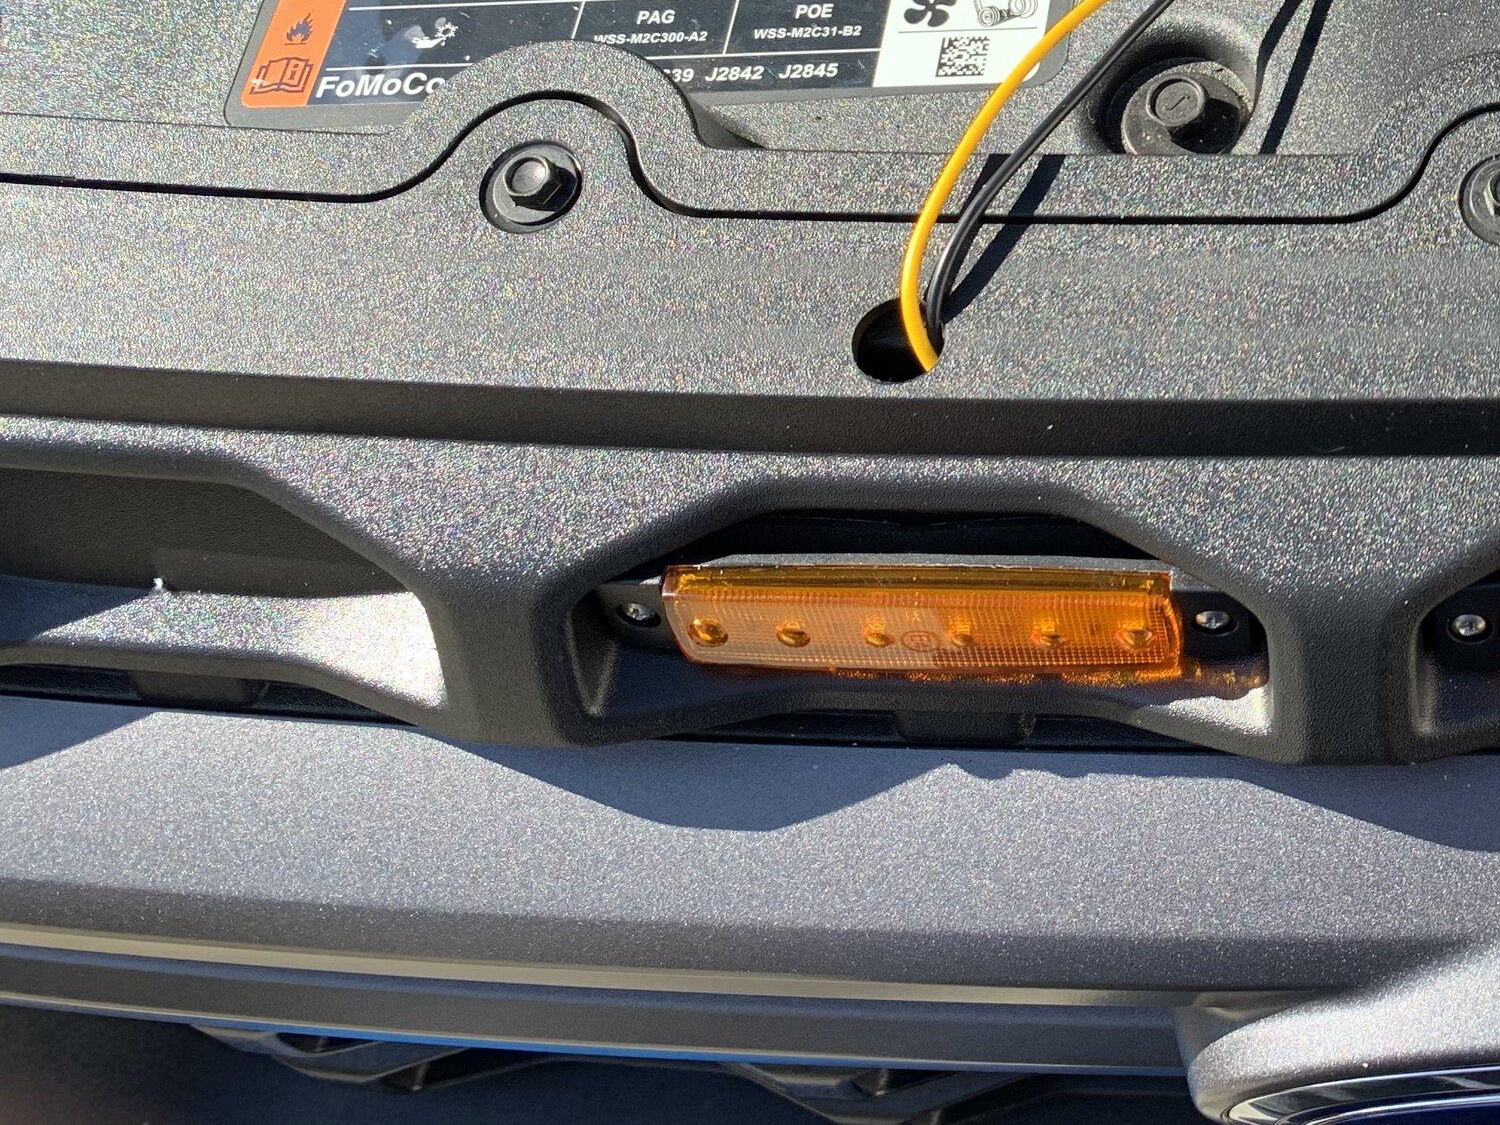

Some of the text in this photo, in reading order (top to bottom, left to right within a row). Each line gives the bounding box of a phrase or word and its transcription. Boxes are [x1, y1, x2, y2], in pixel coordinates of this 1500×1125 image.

[636, 10, 675, 25] PAG
[795, 4, 834, 19] POE
[753, 26, 862, 40] WSS-M2C31-B2
[705, 66, 765, 82] J2842
[779, 63, 838, 79] J2845
[315, 72, 444, 98] FoMoCo
